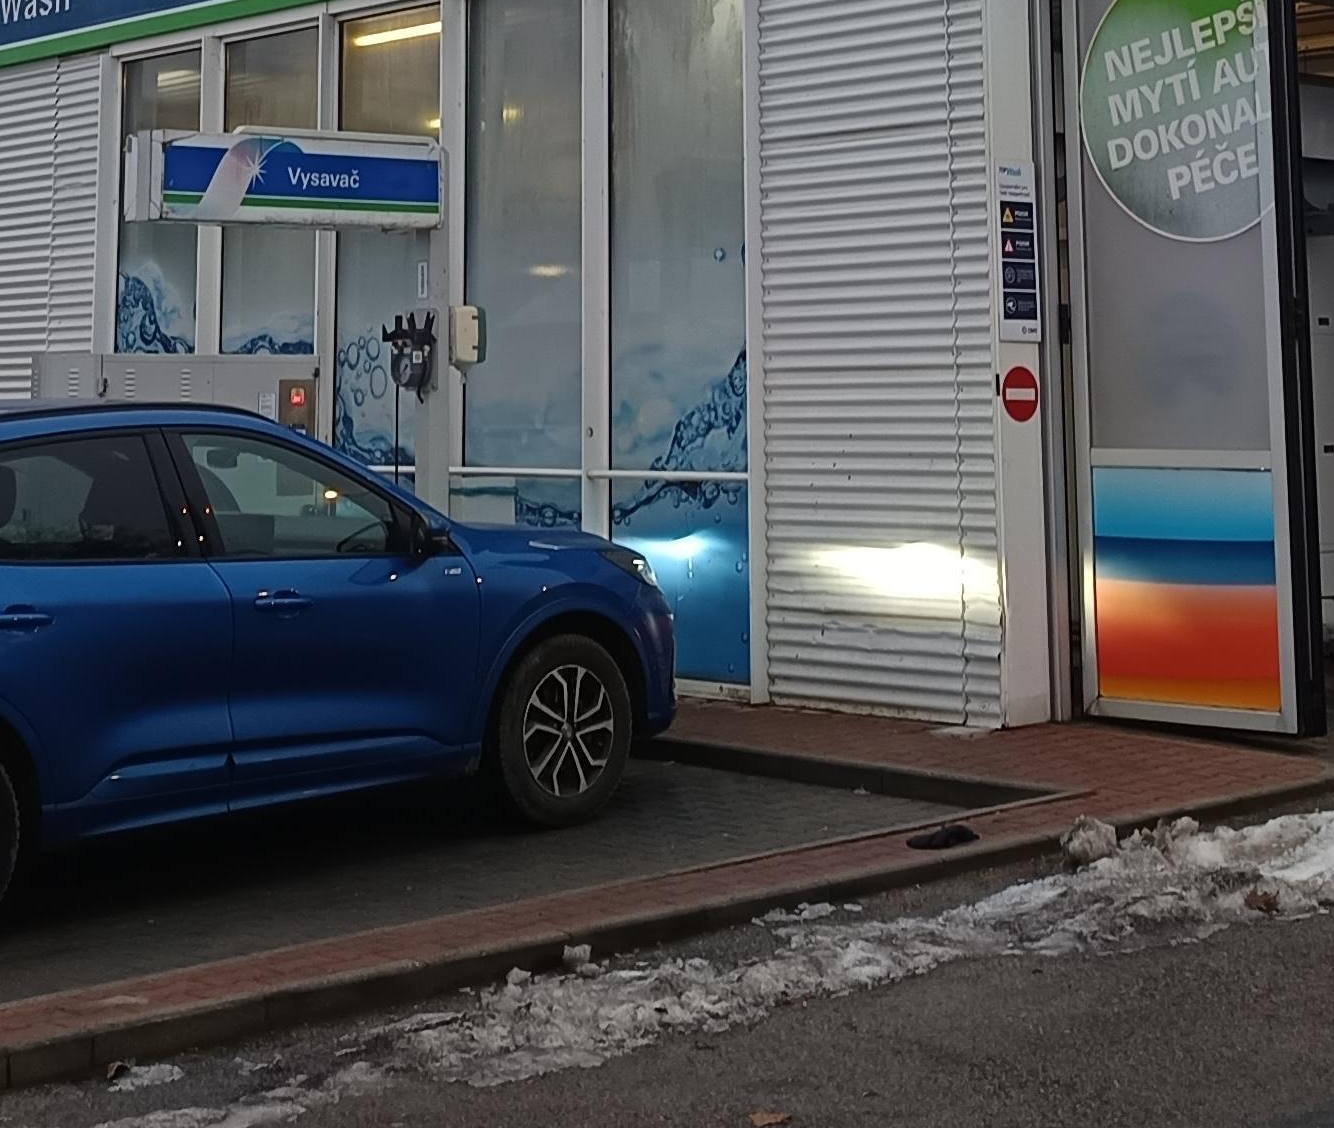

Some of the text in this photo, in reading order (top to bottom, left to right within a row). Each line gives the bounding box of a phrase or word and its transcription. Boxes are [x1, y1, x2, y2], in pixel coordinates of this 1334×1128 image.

[1108, 58, 1201, 126] MYTÍ
[287, 166, 360, 190] Vysavač
[1168, 141, 1259, 201] PÉČE
